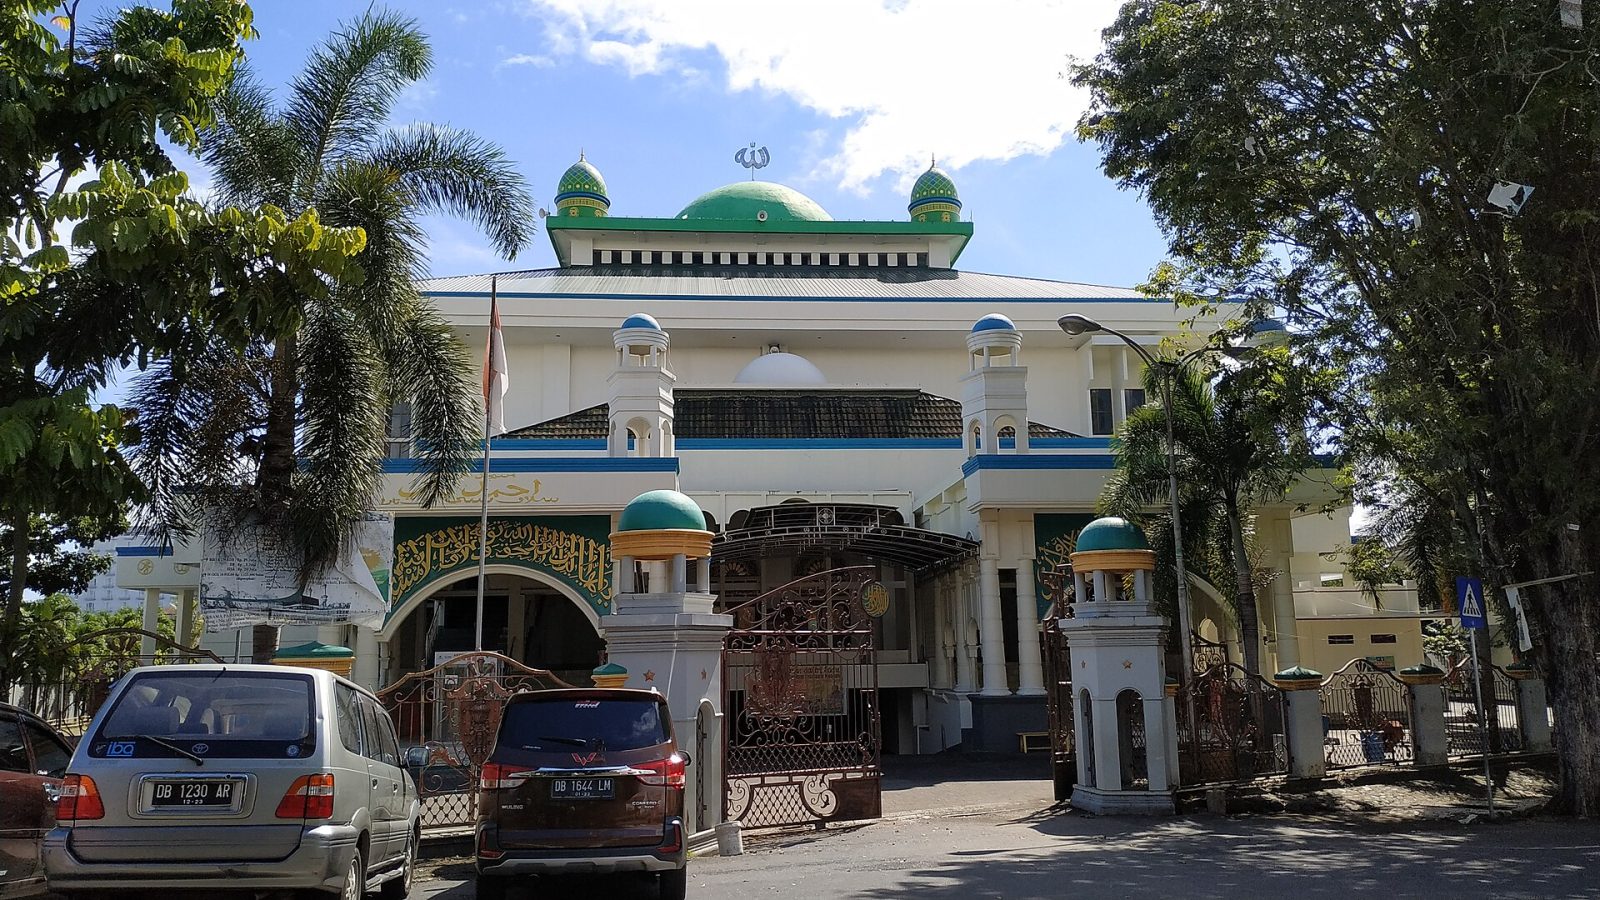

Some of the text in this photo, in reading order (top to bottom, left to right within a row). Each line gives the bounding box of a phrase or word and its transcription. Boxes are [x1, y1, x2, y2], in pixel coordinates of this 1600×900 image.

[735, 142, 770, 169] الله
[156, 783, 230, 798] DB 1230 AR
[555, 779, 611, 792] DB 1644 LM
